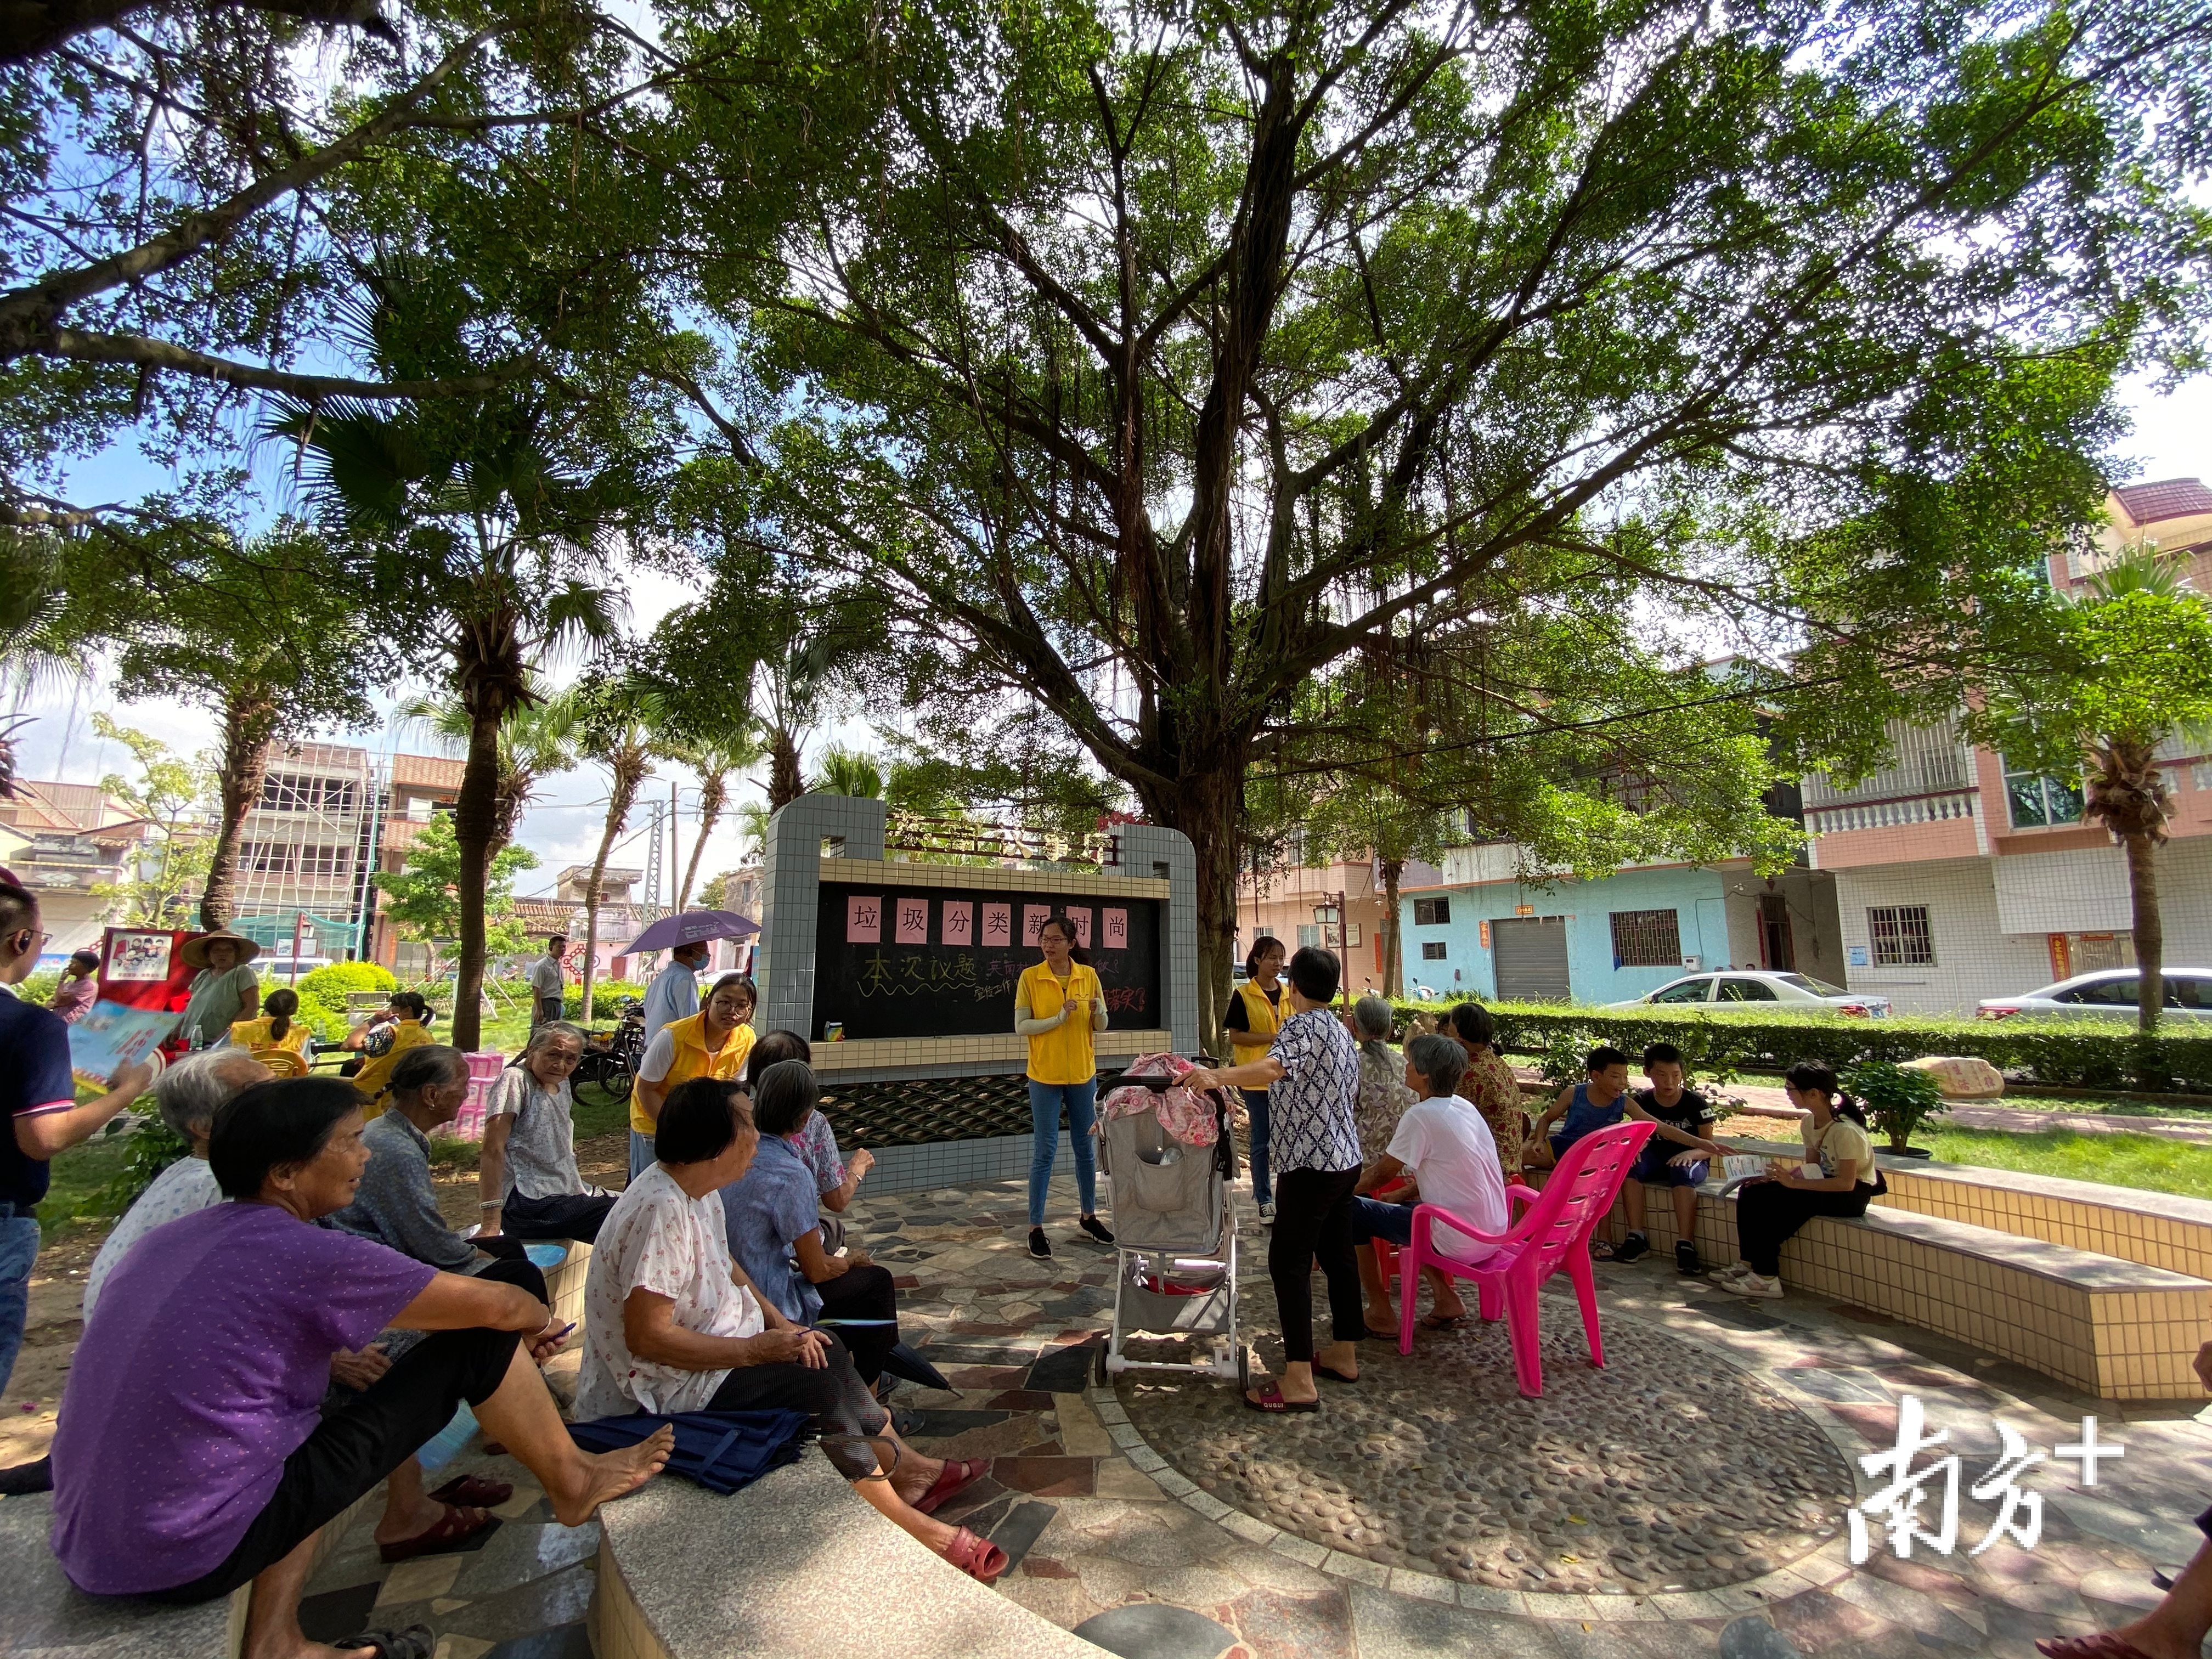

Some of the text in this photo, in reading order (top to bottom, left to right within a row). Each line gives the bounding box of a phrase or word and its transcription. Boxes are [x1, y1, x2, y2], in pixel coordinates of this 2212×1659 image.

[854, 905, 1124, 937] 垃圾分类新时尚
[862, 949, 977, 988] 本次议题
